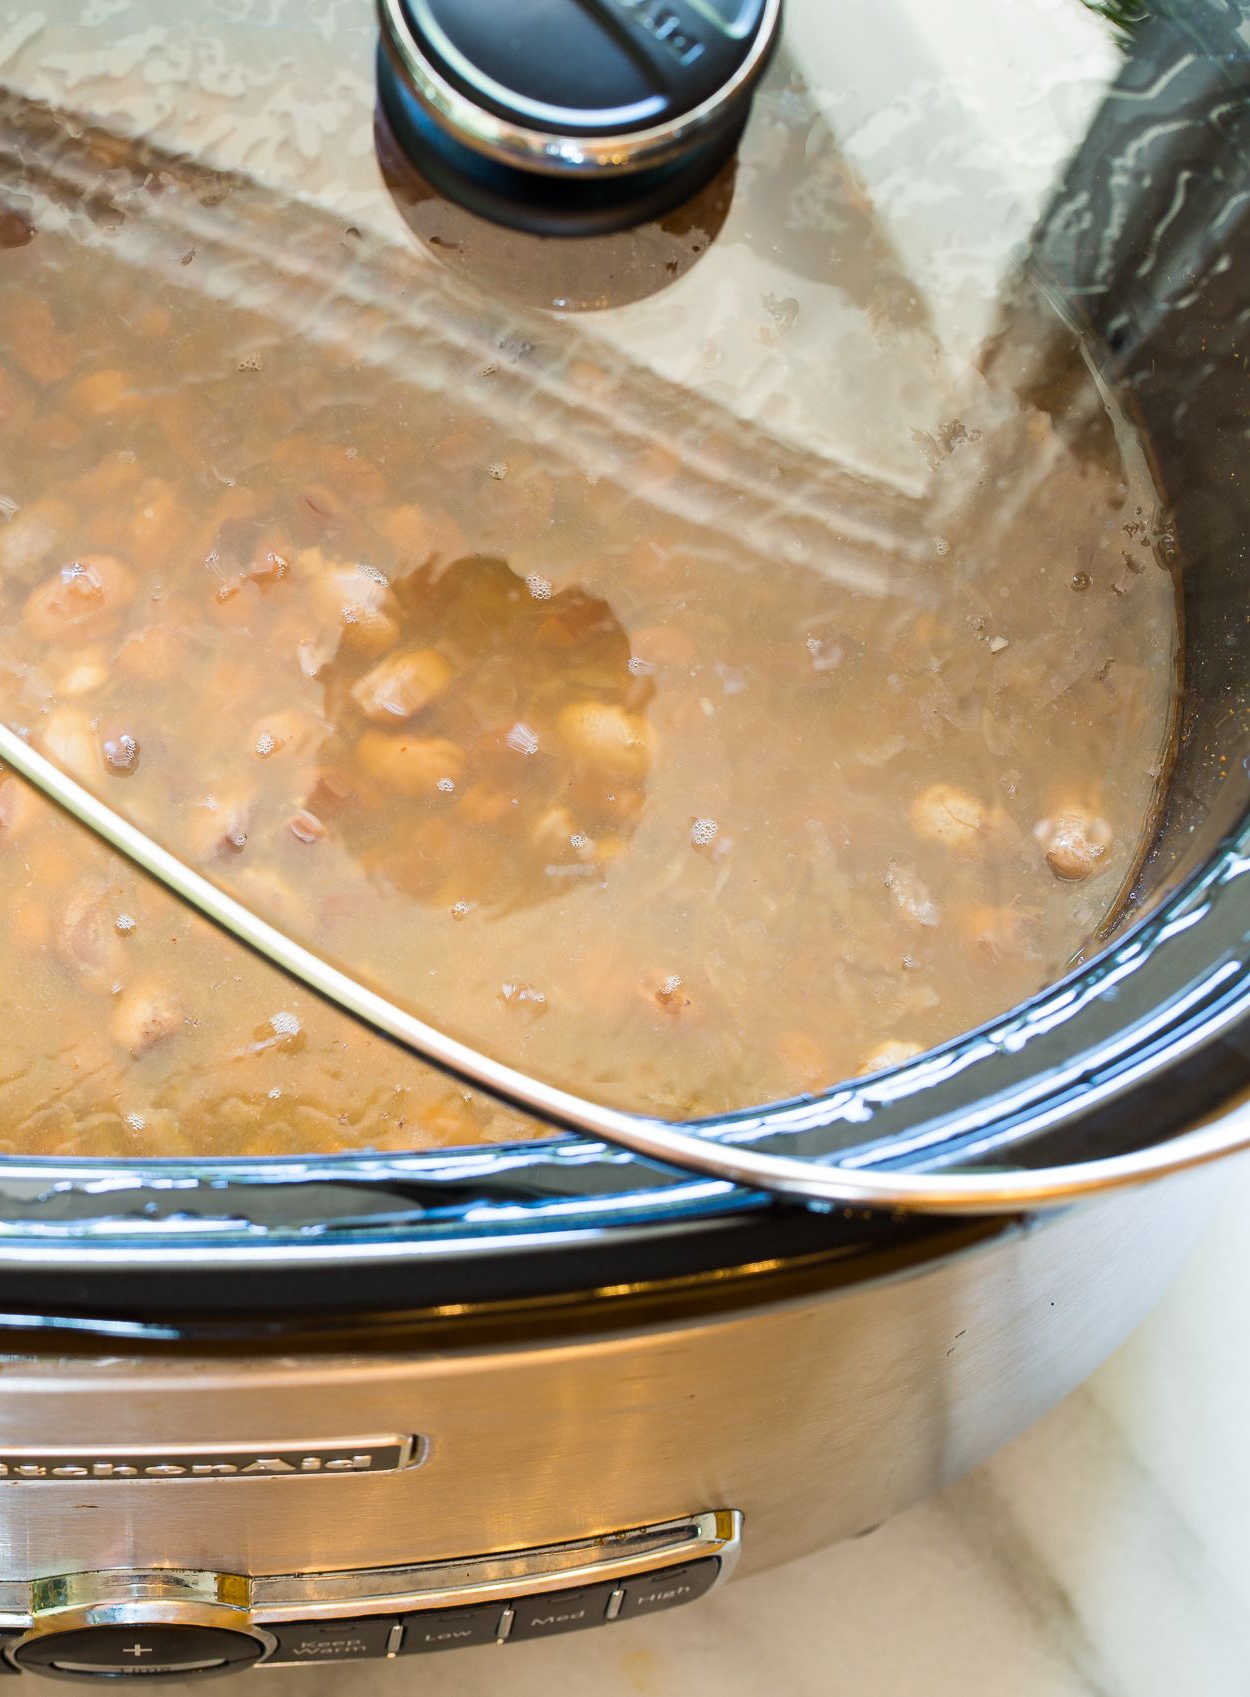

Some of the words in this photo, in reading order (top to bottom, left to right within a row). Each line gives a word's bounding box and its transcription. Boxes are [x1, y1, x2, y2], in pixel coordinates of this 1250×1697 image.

[637, 1585, 691, 1606] High
[531, 1609, 585, 1627] Med
[424, 1630, 473, 1642] Low
[293, 1645, 367, 1656] Warm
